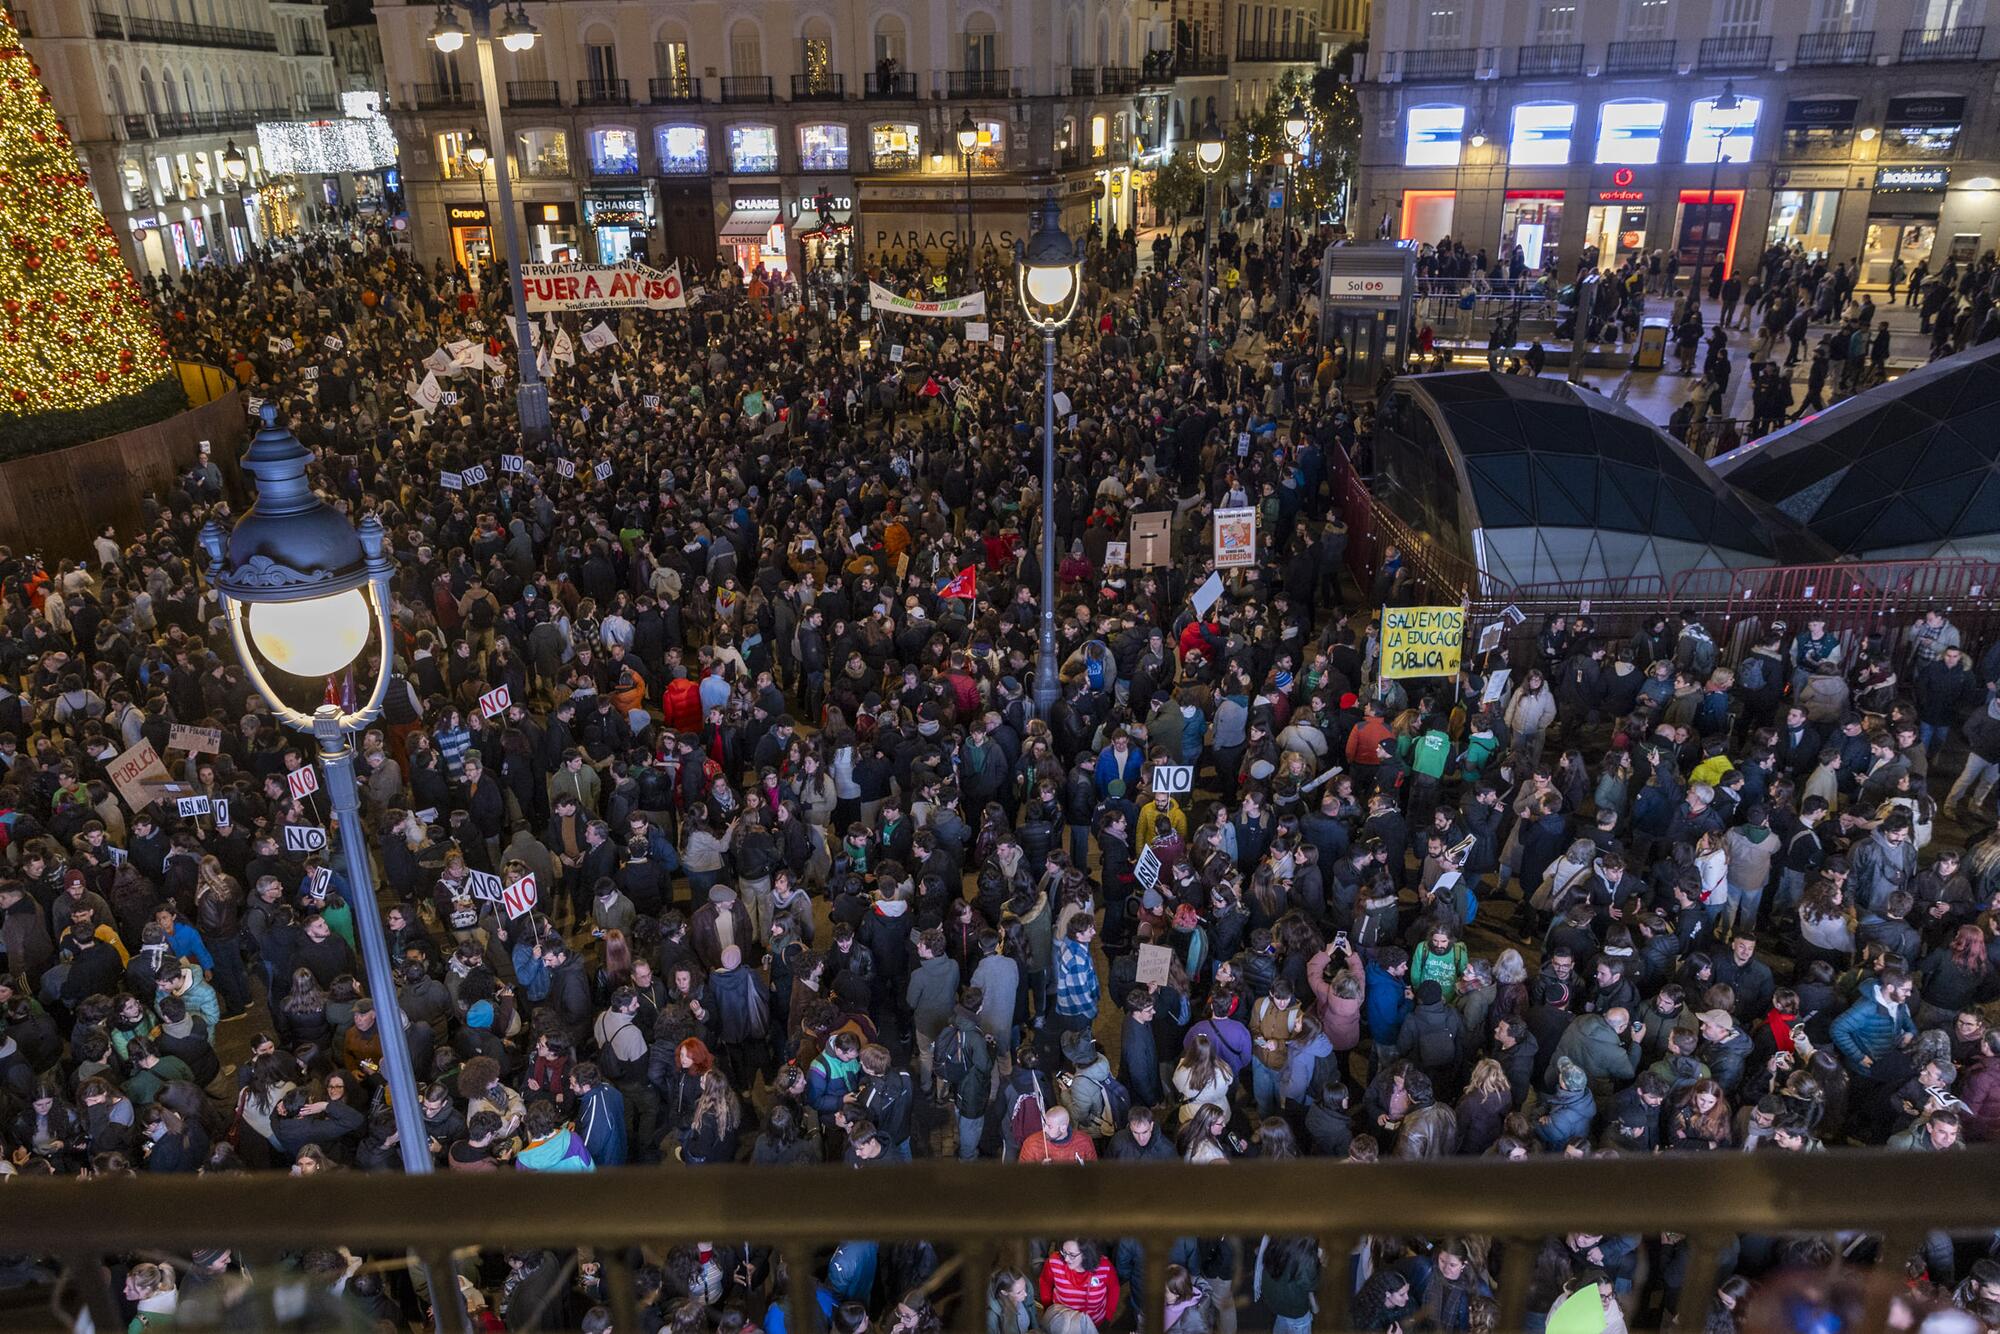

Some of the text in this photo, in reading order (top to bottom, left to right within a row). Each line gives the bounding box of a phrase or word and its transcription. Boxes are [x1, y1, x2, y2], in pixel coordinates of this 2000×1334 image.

[1882, 172, 1942, 183] RODILLA
[1600, 191, 1643, 200] vodafone
[595, 201, 640, 210] CHANGE
[735, 199, 779, 209] CHANGE
[452, 209, 485, 220] Orange
[877, 230, 1013, 249] PARAGUAS
[523, 275, 603, 301] FUERA
[1348, 281, 1363, 290] Sol
[565, 300, 600, 310] Sindicato
[305, 366, 319, 379] NO
[492, 376, 506, 388] NO
[645, 396, 660, 406] NO
[502, 456, 522, 471] NO
[557, 459, 574, 476] NO
[595, 462, 611, 478] NO
[463, 466, 486, 485] NO
[1218, 553, 1252, 561] INVERSIÓN
[1387, 612, 1462, 629] SALVEMOS
[1388, 632, 1402, 647] LA
[1392, 647, 1444, 670] PÚBLICA
[481, 687, 508, 716] NO
[171, 724, 186, 733] SIN
[289, 767, 316, 798] NO
[1154, 768, 1191, 791] NO
[196, 799, 208, 813] NO
[287, 828, 326, 850] NO
[472, 871, 503, 900] NO
[503, 877, 536, 917] NO
